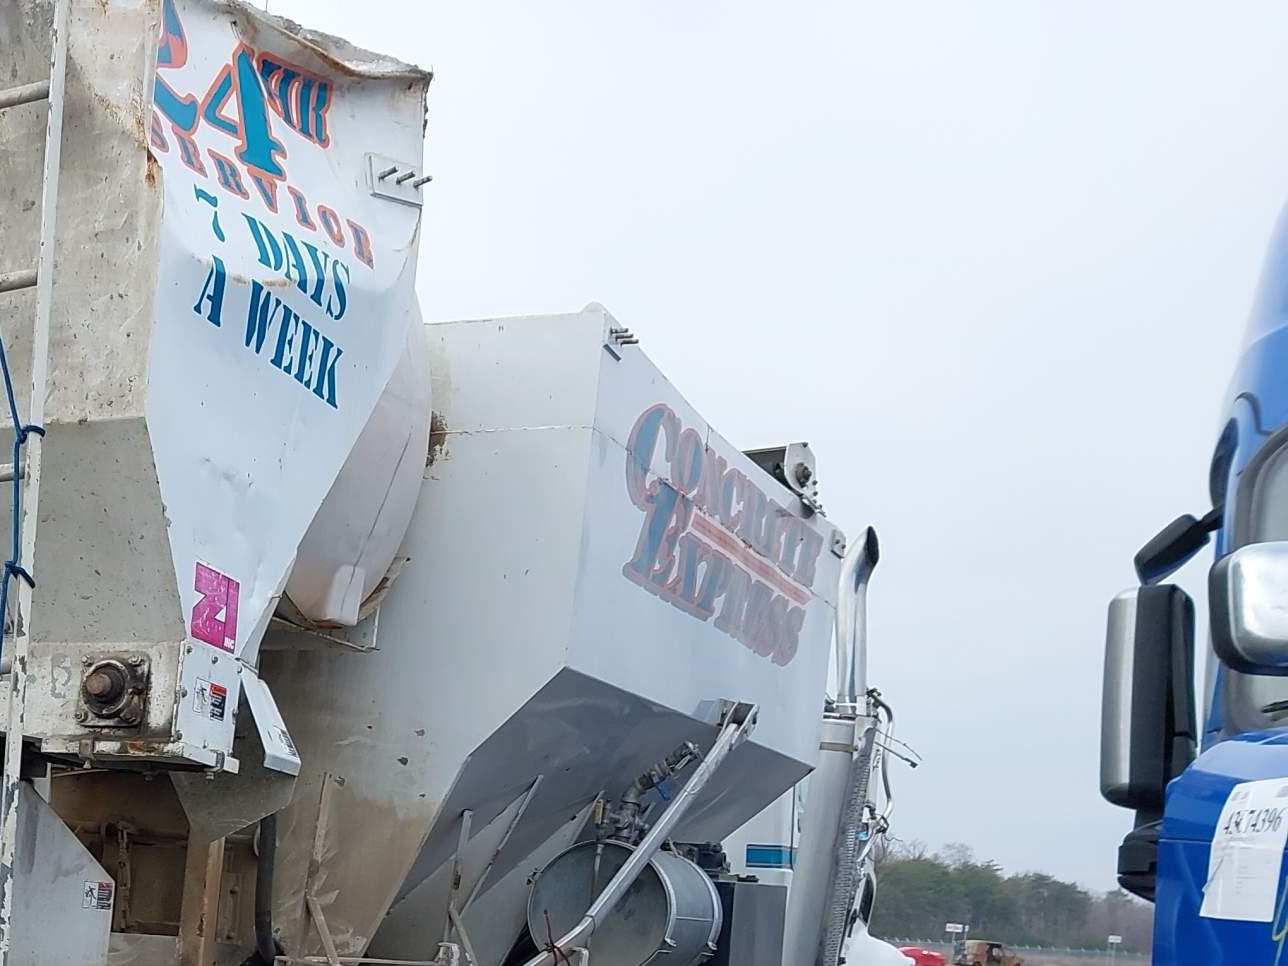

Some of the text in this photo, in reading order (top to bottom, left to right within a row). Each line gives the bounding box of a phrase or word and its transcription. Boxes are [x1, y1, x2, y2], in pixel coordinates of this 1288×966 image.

[194, 184, 350, 321] 7 DAYS
[193, 254, 343, 409] A WEEK
